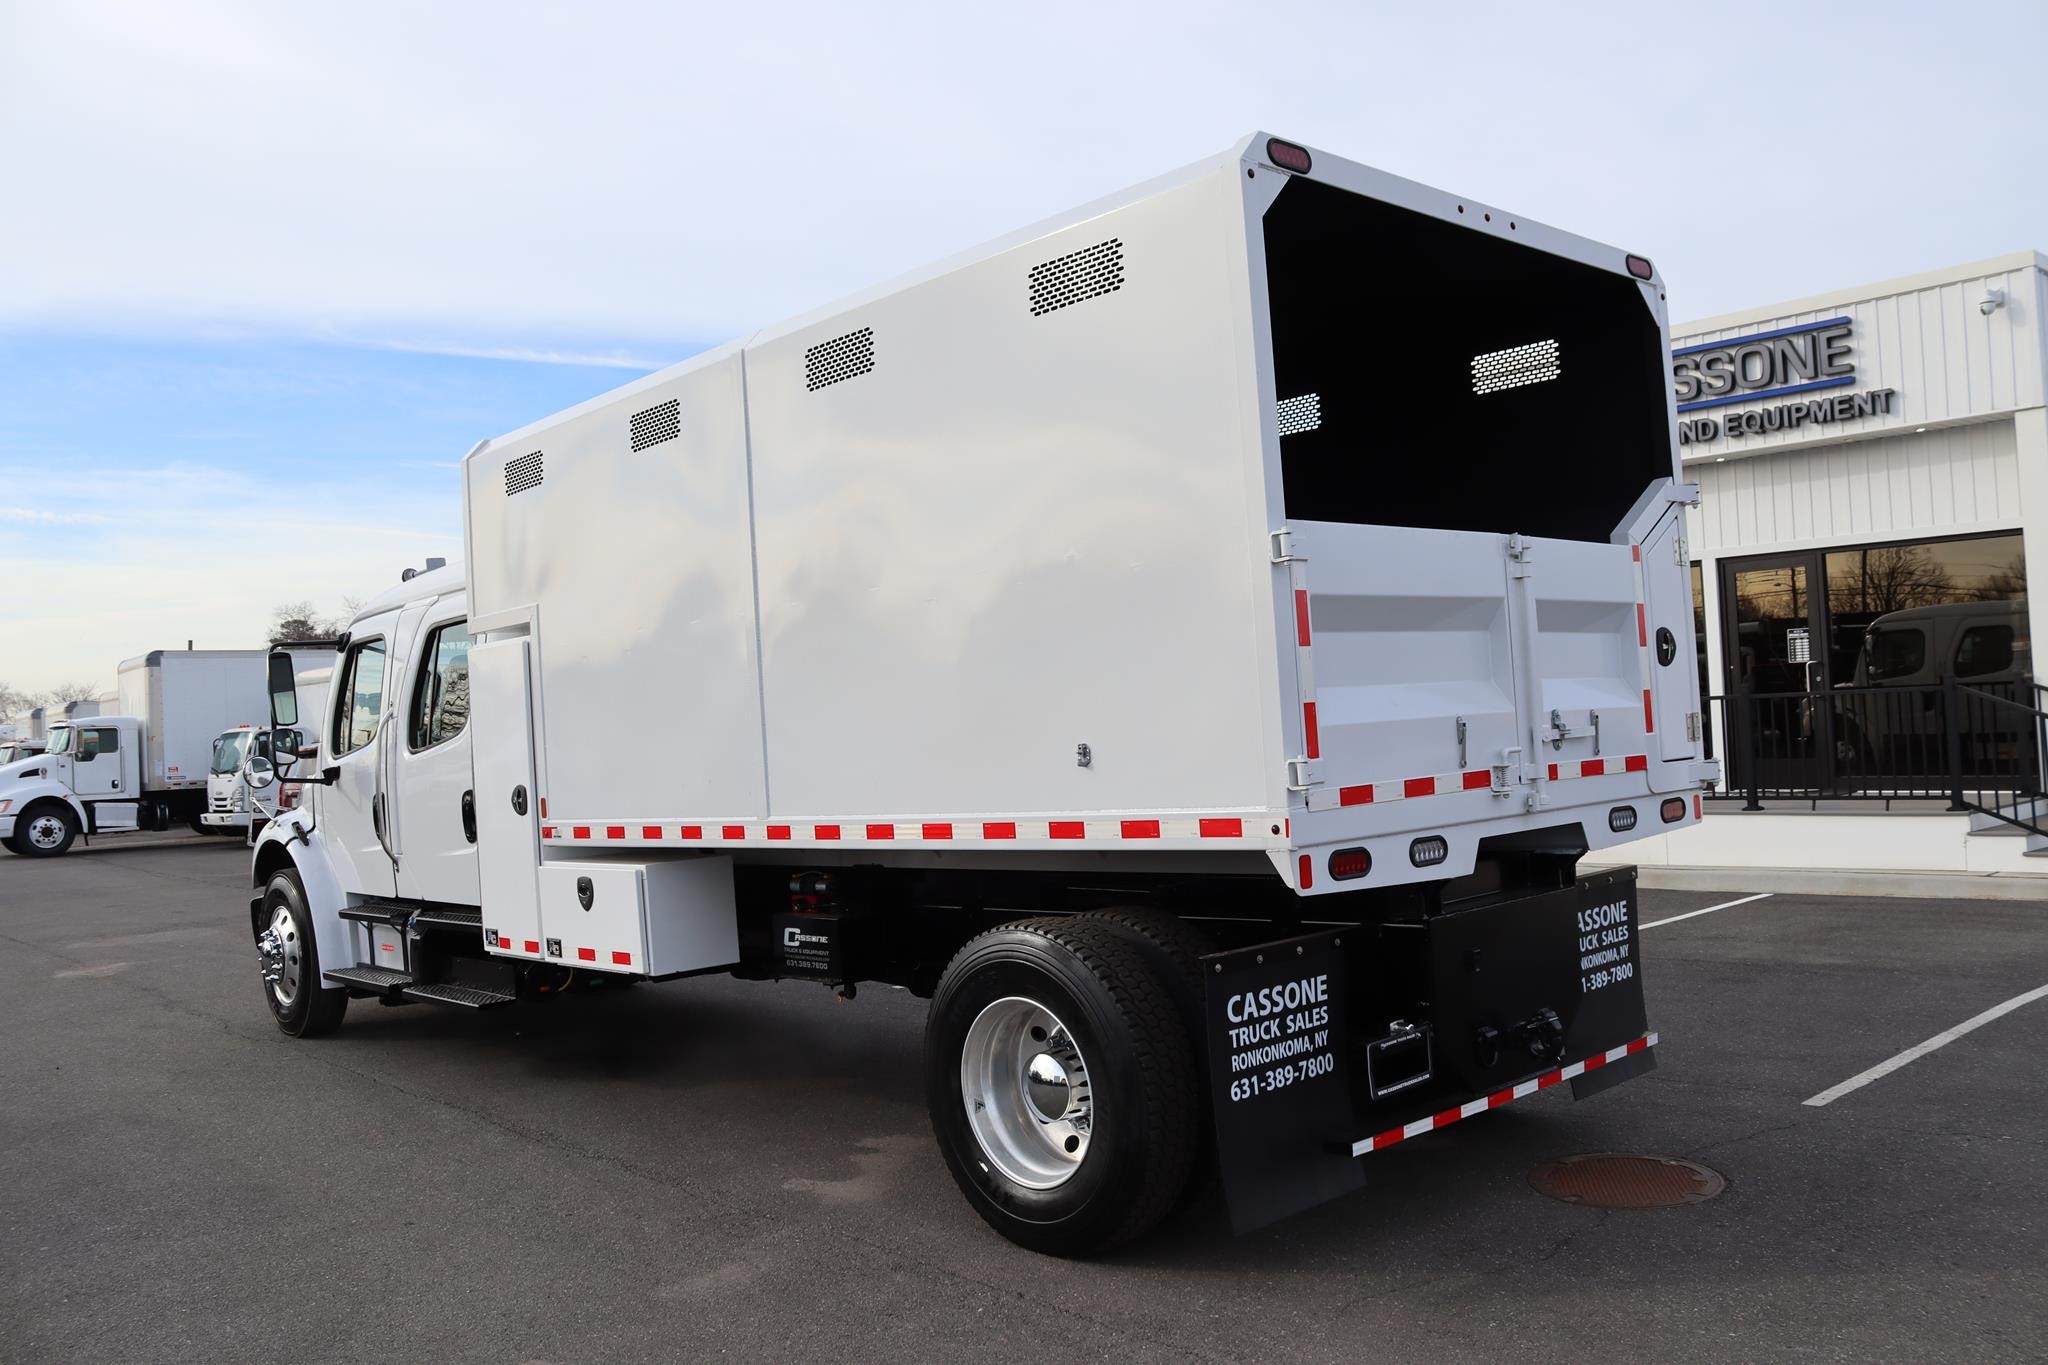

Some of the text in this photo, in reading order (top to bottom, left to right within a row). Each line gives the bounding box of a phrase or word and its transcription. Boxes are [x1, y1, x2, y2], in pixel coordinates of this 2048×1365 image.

[1673, 327, 1855, 401] SSONE
[1678, 388, 1895, 445] ND EQUIPMENT
[1577, 900, 1628, 932] ASSONE
[1579, 925, 1629, 952] UCK SALES
[1620, 944, 1629, 959] NY
[1227, 974, 1328, 1023] CASSONE
[1581, 962, 1633, 993] 1-389-7800
[1229, 1006, 1329, 1048] TRUCK SALES
[1231, 1029, 1329, 1072] RONKONKOMA, NY
[1230, 1053, 1334, 1102] 631-389-7800
